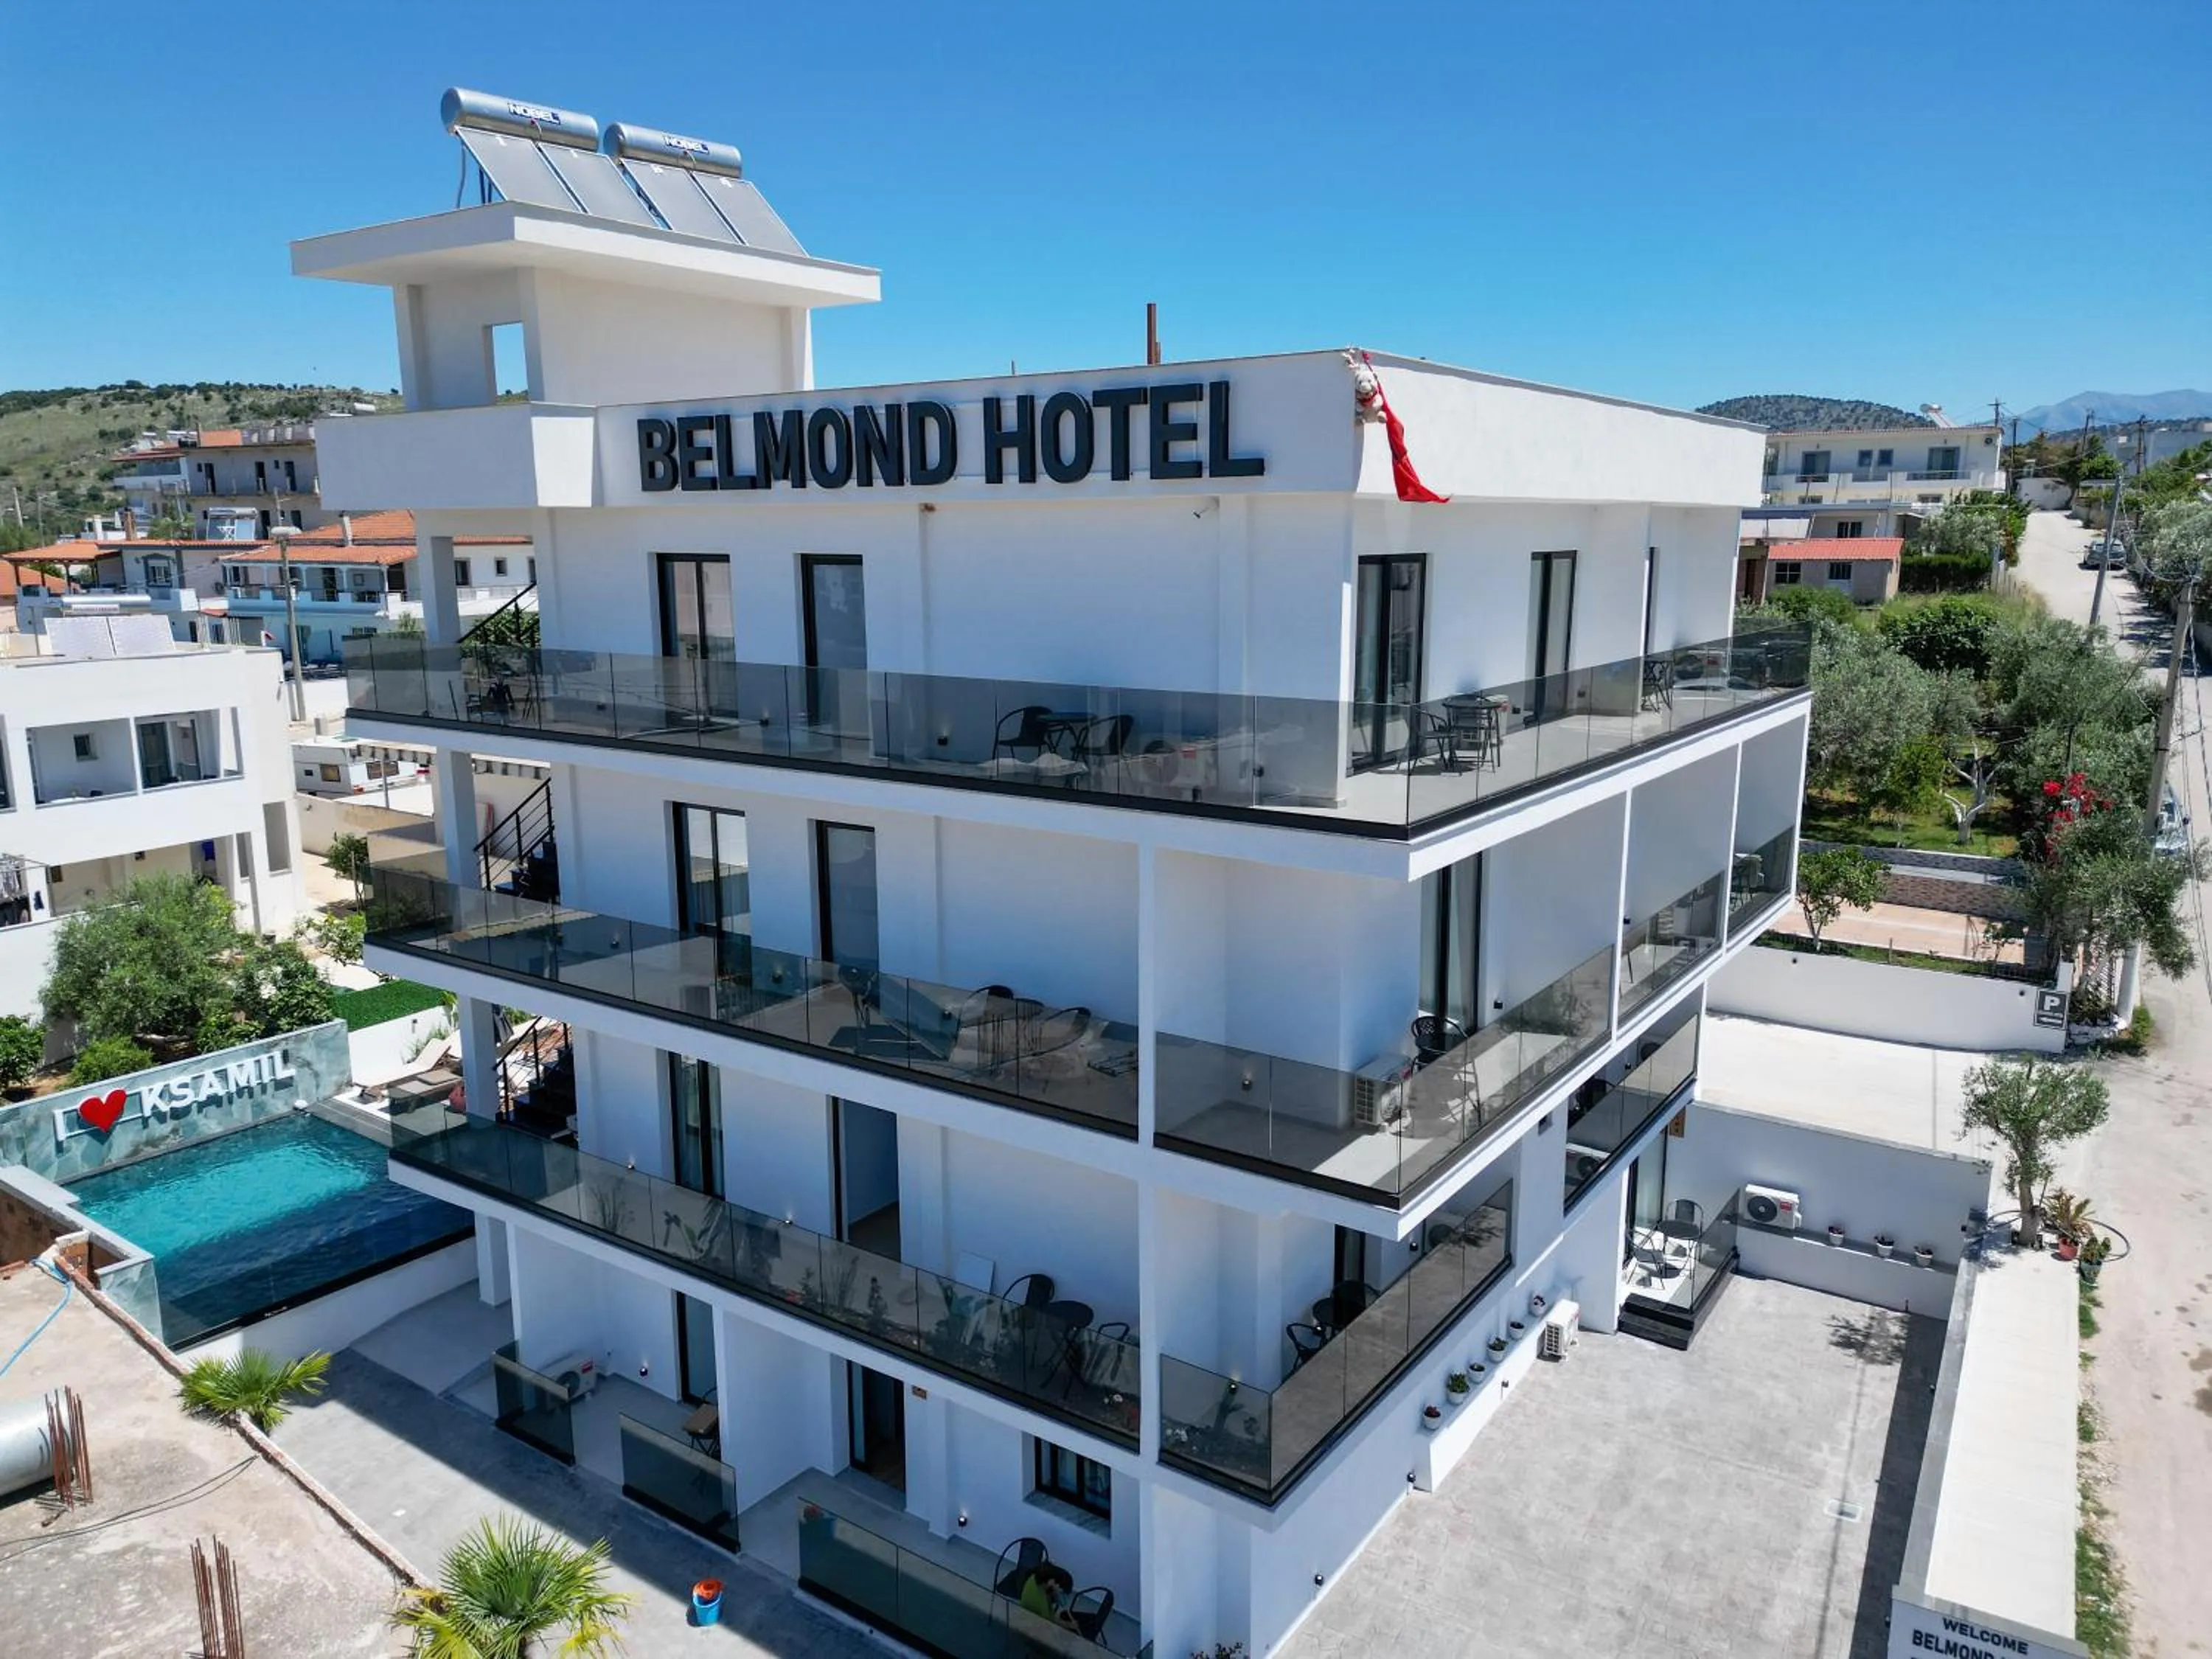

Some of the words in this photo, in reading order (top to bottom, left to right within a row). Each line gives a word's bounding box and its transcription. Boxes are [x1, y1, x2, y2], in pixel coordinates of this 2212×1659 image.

[636, 400, 957, 492] BELMOND
[982, 380, 1265, 484] HOTEL
[2043, 995, 2061, 1011] P
[139, 1049, 296, 1117] KSAMIL
[1942, 1618, 2029, 1655] WELCOME
